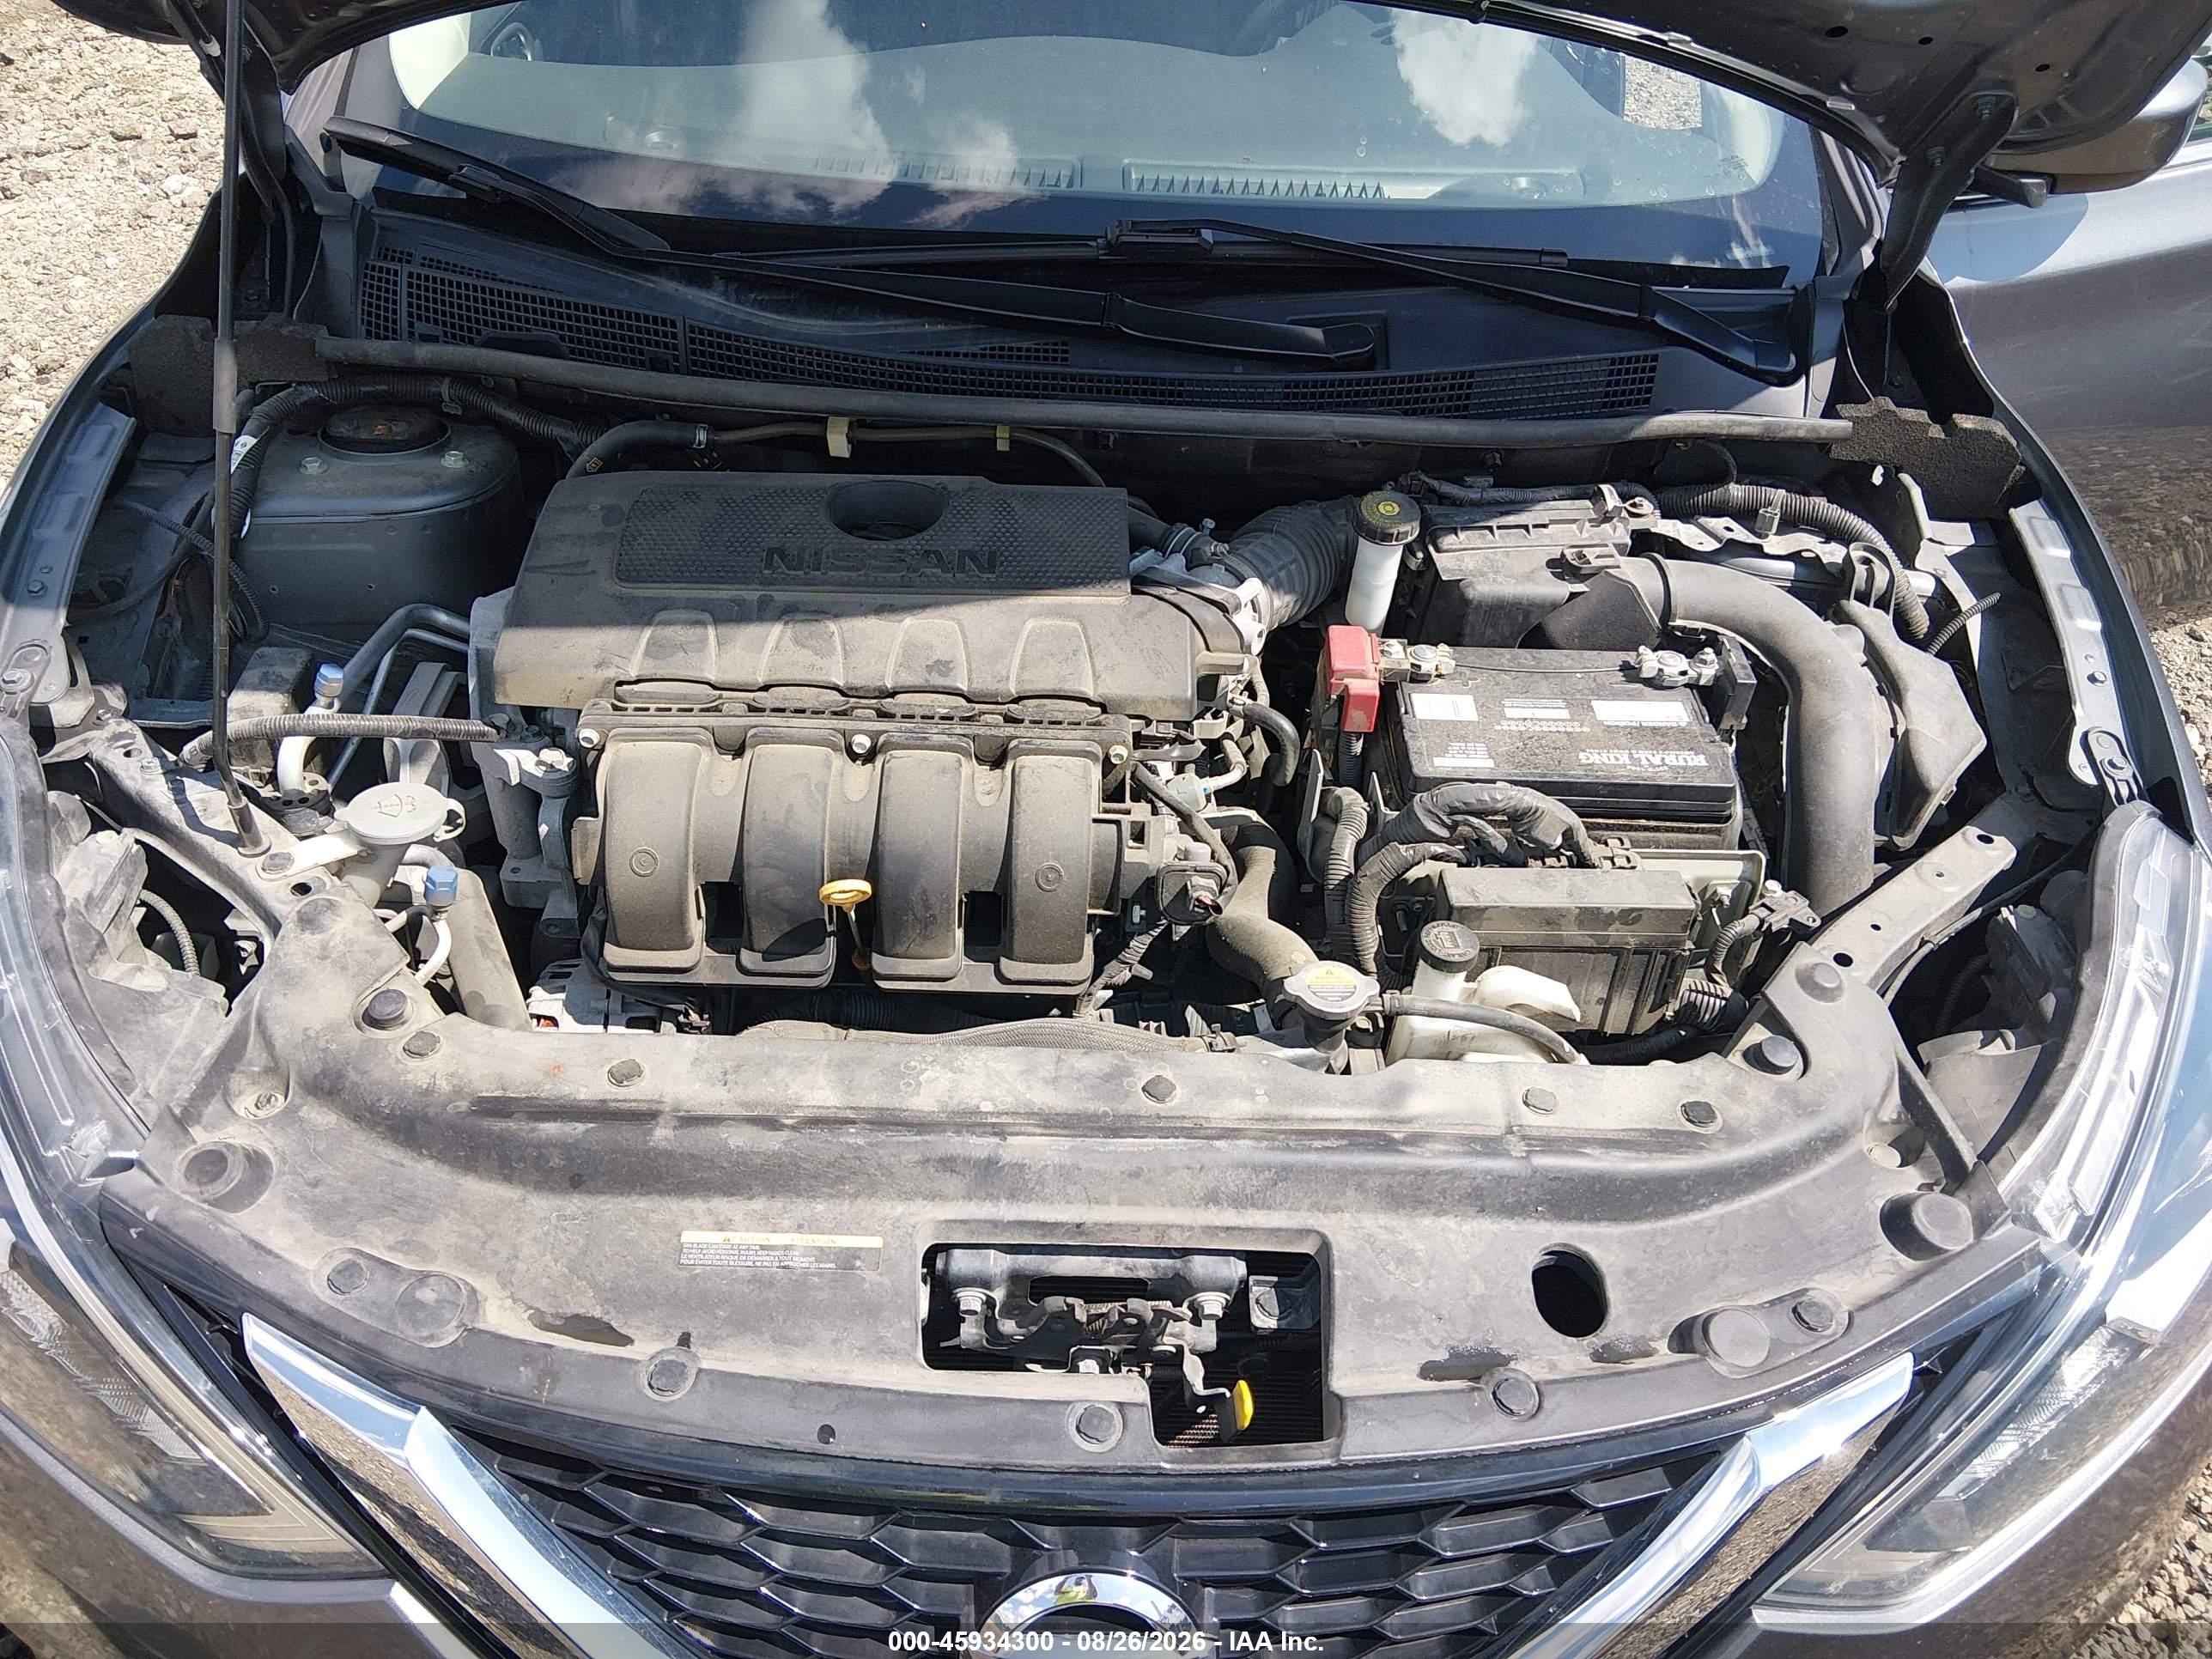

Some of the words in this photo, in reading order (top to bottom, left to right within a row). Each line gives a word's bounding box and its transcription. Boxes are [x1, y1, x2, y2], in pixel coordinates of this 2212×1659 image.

[762, 547, 998, 577] NISSAN
[1578, 751, 1632, 764] KING
[1633, 753, 1709, 766] RURAL
